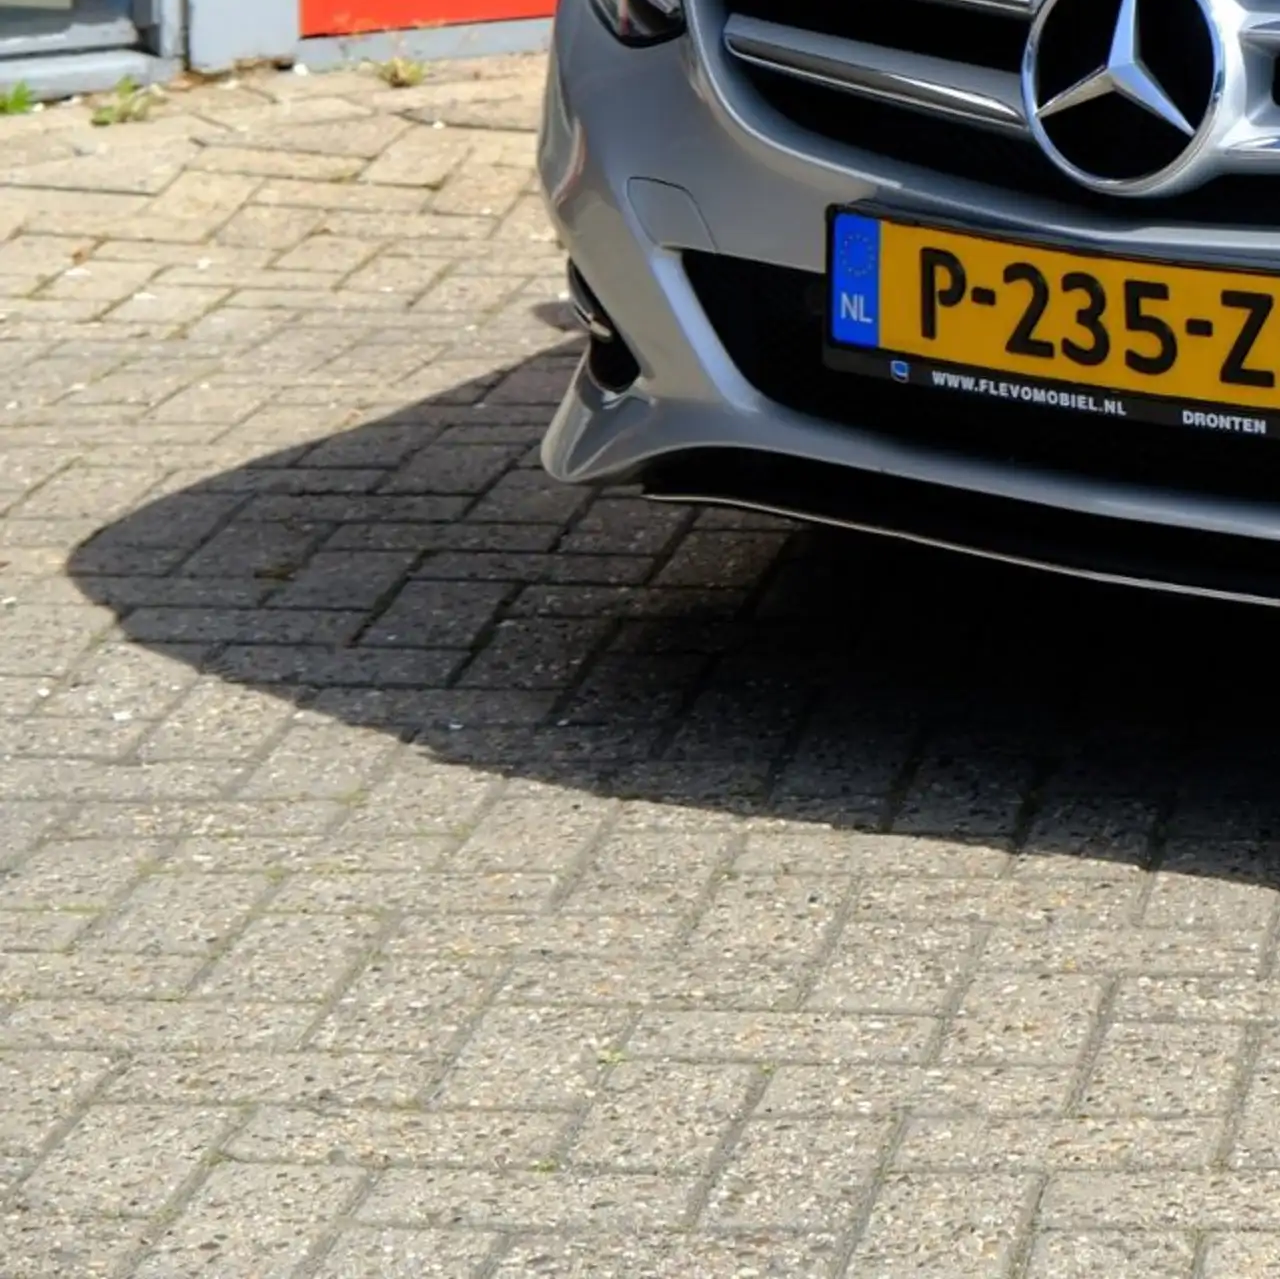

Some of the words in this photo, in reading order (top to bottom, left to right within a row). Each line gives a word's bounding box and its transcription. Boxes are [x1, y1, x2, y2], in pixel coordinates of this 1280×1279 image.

[840, 293, 873, 324] NL
[931, 369, 1127, 417] WWW.FLEVOMOBIEL.NL
[1182, 409, 1267, 435] DRONTEN
